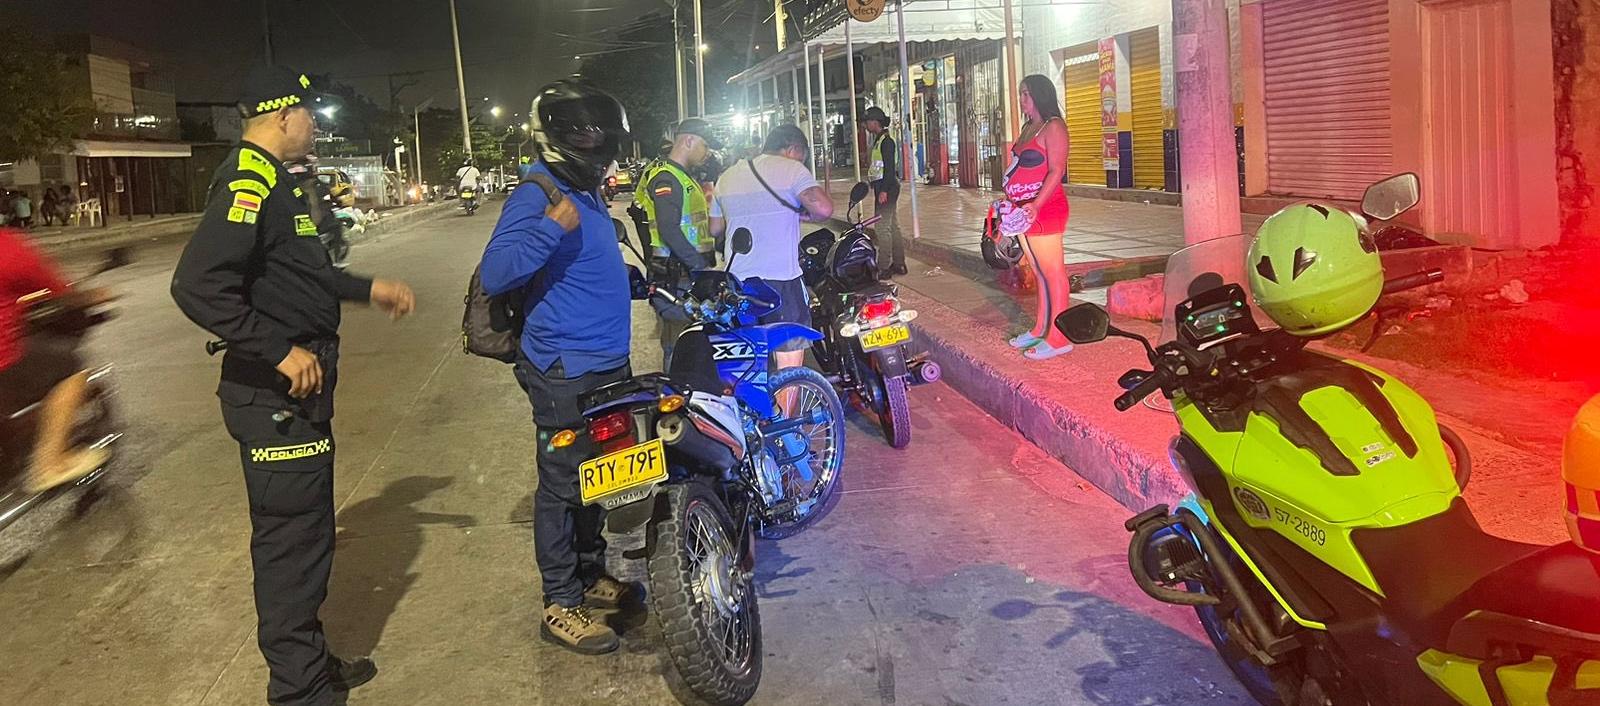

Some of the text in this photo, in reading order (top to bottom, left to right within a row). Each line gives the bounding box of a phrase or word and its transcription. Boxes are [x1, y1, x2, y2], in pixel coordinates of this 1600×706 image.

[853, 6, 879, 17] efecty
[1009, 190, 1040, 202] OUSE
[583, 446, 658, 490] RTY 79F
[1274, 506, 1326, 547] 57-2889
